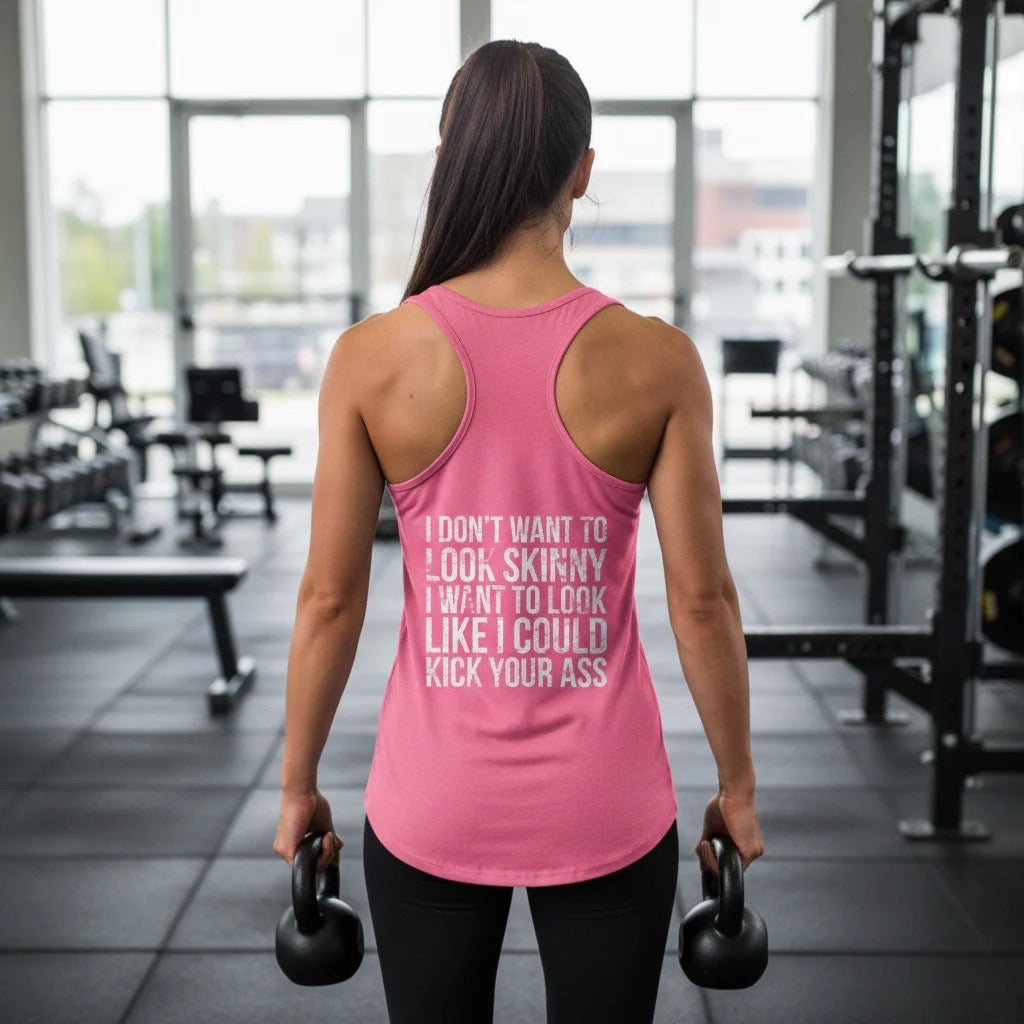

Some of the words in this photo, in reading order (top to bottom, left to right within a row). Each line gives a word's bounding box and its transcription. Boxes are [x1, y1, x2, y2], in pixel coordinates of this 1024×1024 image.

[425, 516, 431, 543] I
[438, 516, 503, 543] DON'T
[510, 516, 572, 543] WANT
[580, 516, 607, 543] TO
[426, 548, 495, 582] LOOK
[503, 548, 607, 582] SKINNY
[425, 586, 431, 614] I
[439, 585, 505, 614] WANT
[512, 585, 540, 614] TO
[548, 585, 607, 614] LOOK
[425, 617, 487, 653] LIKE
[497, 617, 504, 653] I
[513, 617, 607, 654] COULD
[426, 657, 482, 687] KICK
[489, 657, 552, 687] YOUR
[560, 657, 607, 687] ASS
